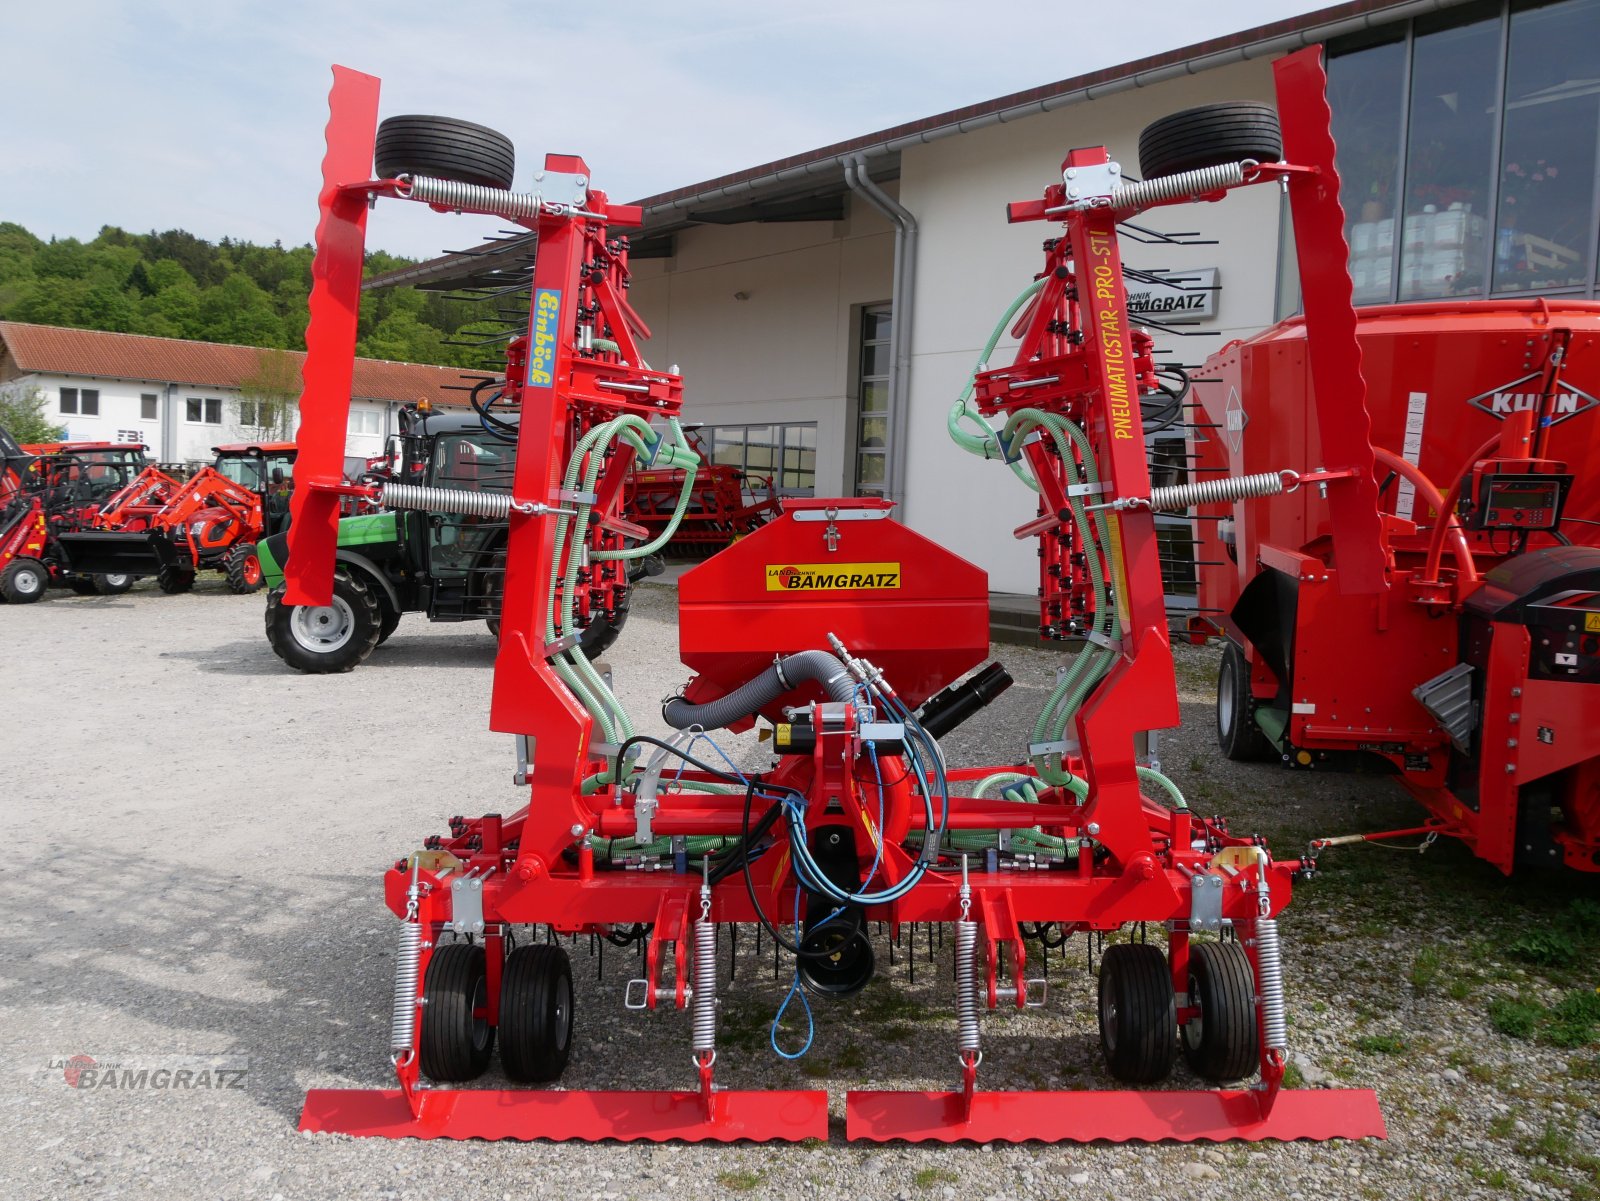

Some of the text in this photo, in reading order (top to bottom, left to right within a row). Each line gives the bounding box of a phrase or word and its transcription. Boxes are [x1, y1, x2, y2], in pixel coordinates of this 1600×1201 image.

[531, 291, 559, 385] Einböck
[1089, 230, 1133, 440] PNEUMATICSTAR-PRO-STI
[787, 573, 898, 589] BAMGRATZ
